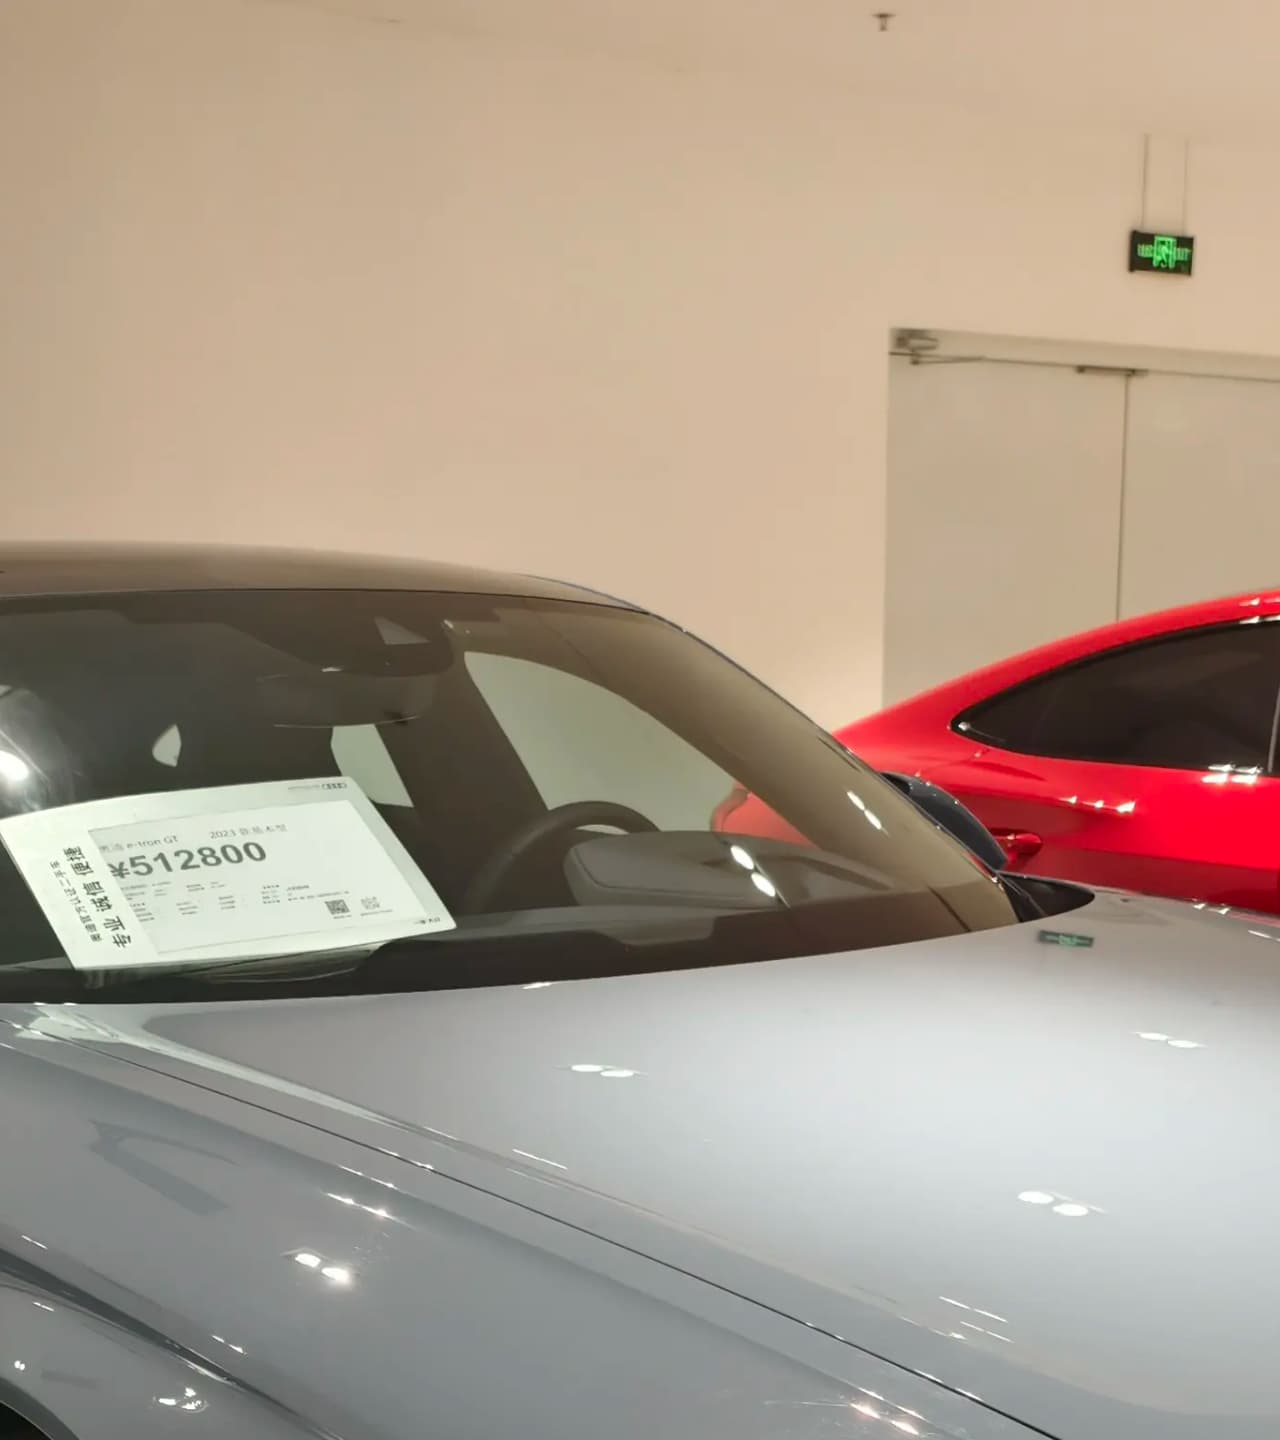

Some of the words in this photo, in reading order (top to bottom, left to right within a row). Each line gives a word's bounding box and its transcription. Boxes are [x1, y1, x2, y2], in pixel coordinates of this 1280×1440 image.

[63, 846, 94, 876] 便捷
[107, 842, 267, 879] ¥512800
[82, 880, 113, 912] 诚信
[103, 915, 132, 948] 专业
